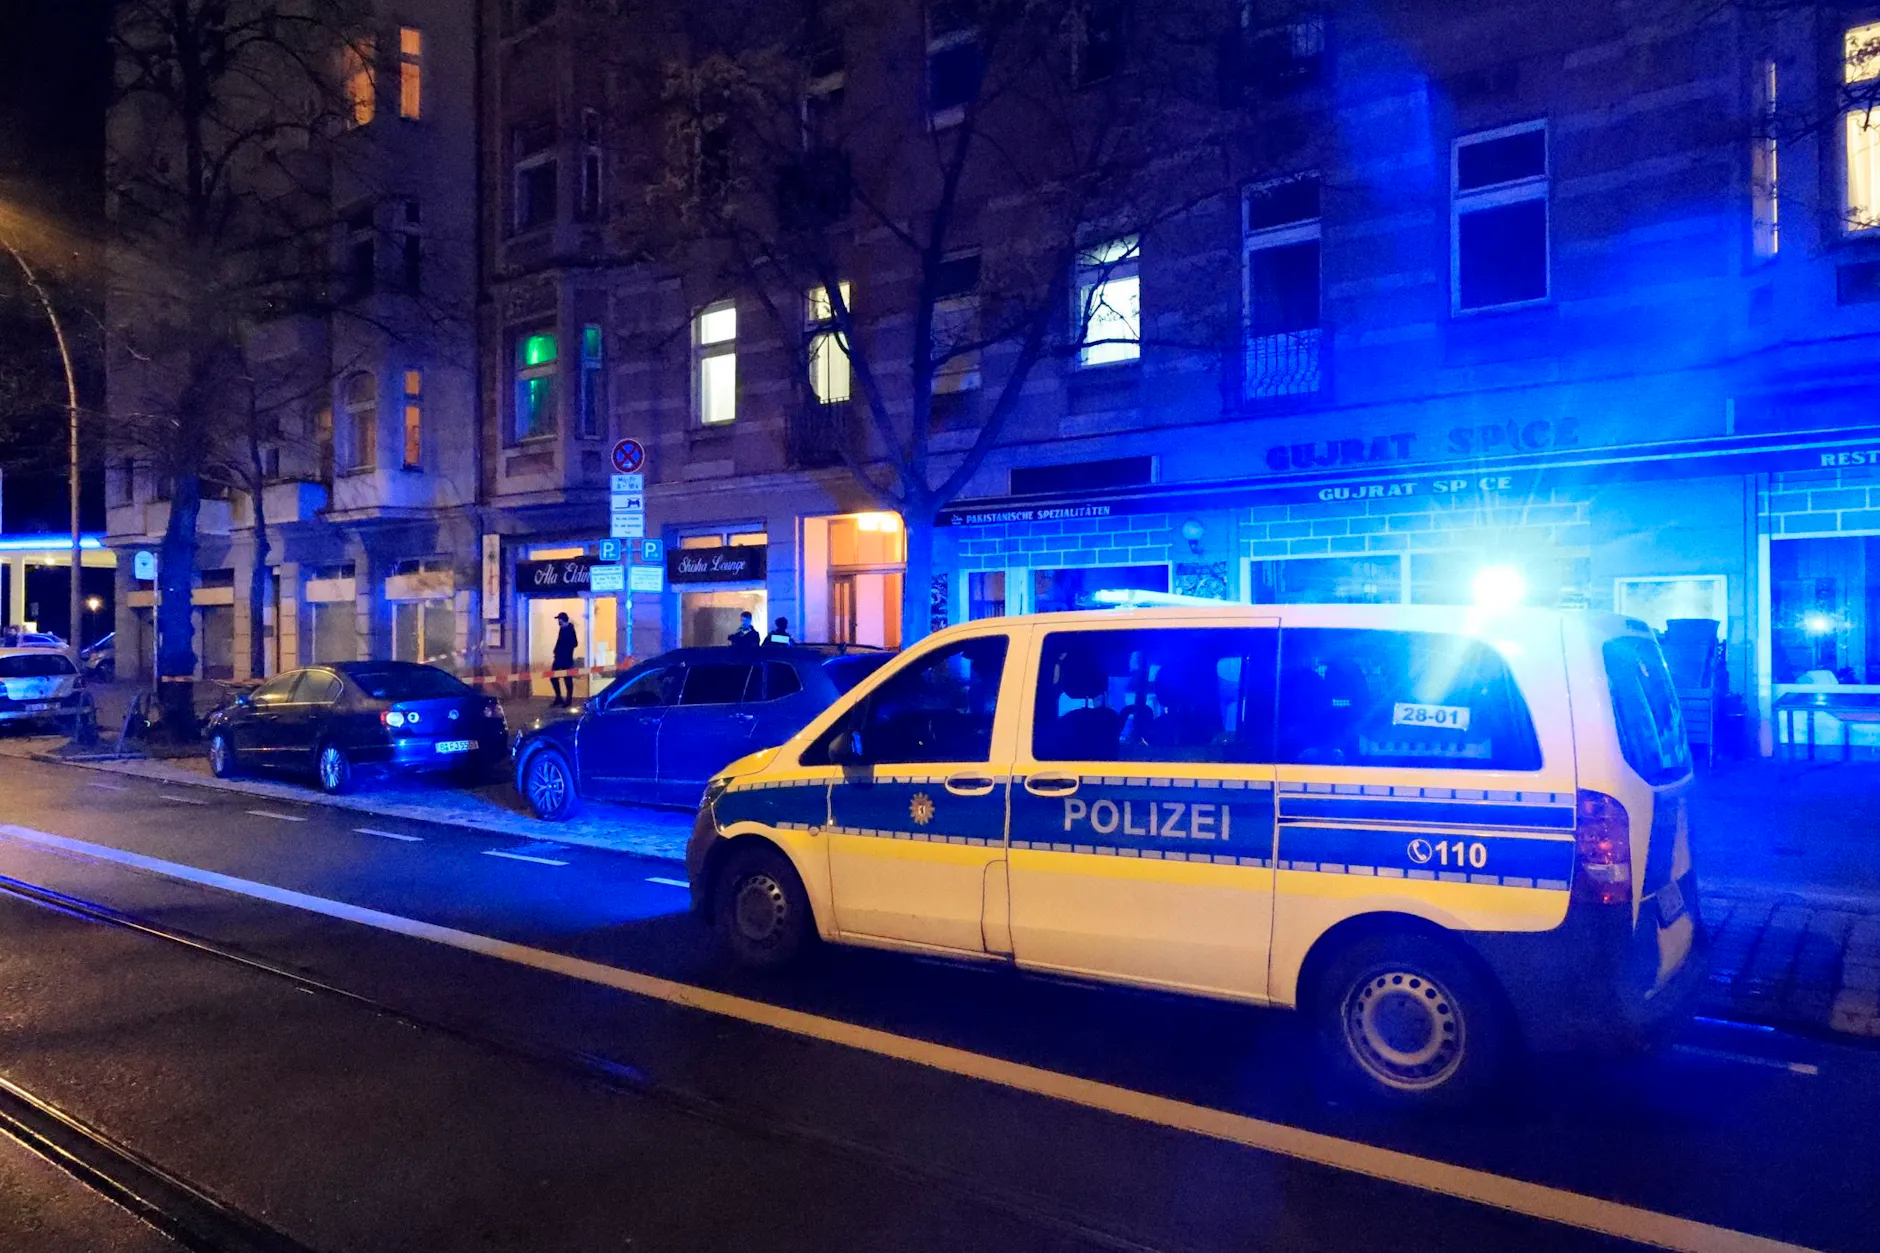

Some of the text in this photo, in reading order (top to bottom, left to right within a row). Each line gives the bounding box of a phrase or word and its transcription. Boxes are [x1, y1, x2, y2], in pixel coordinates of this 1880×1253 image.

[1265, 432, 1417, 471] GUJRAT
[1820, 450, 1880, 467] REST
[1318, 482, 1418, 501] GUJRAT
[966, 504, 1110, 524] PAKISTANISCHE SPEZIALITÄTEN
[603, 542, 614, 557] P
[645, 542, 656, 558] P
[534, 563, 558, 584] Ala
[678, 554, 746, 575] Shisha Lounge
[1402, 707, 1459, 725] 28-01
[1064, 798, 1230, 841] POLIZEI
[1435, 840, 1487, 869] 110
